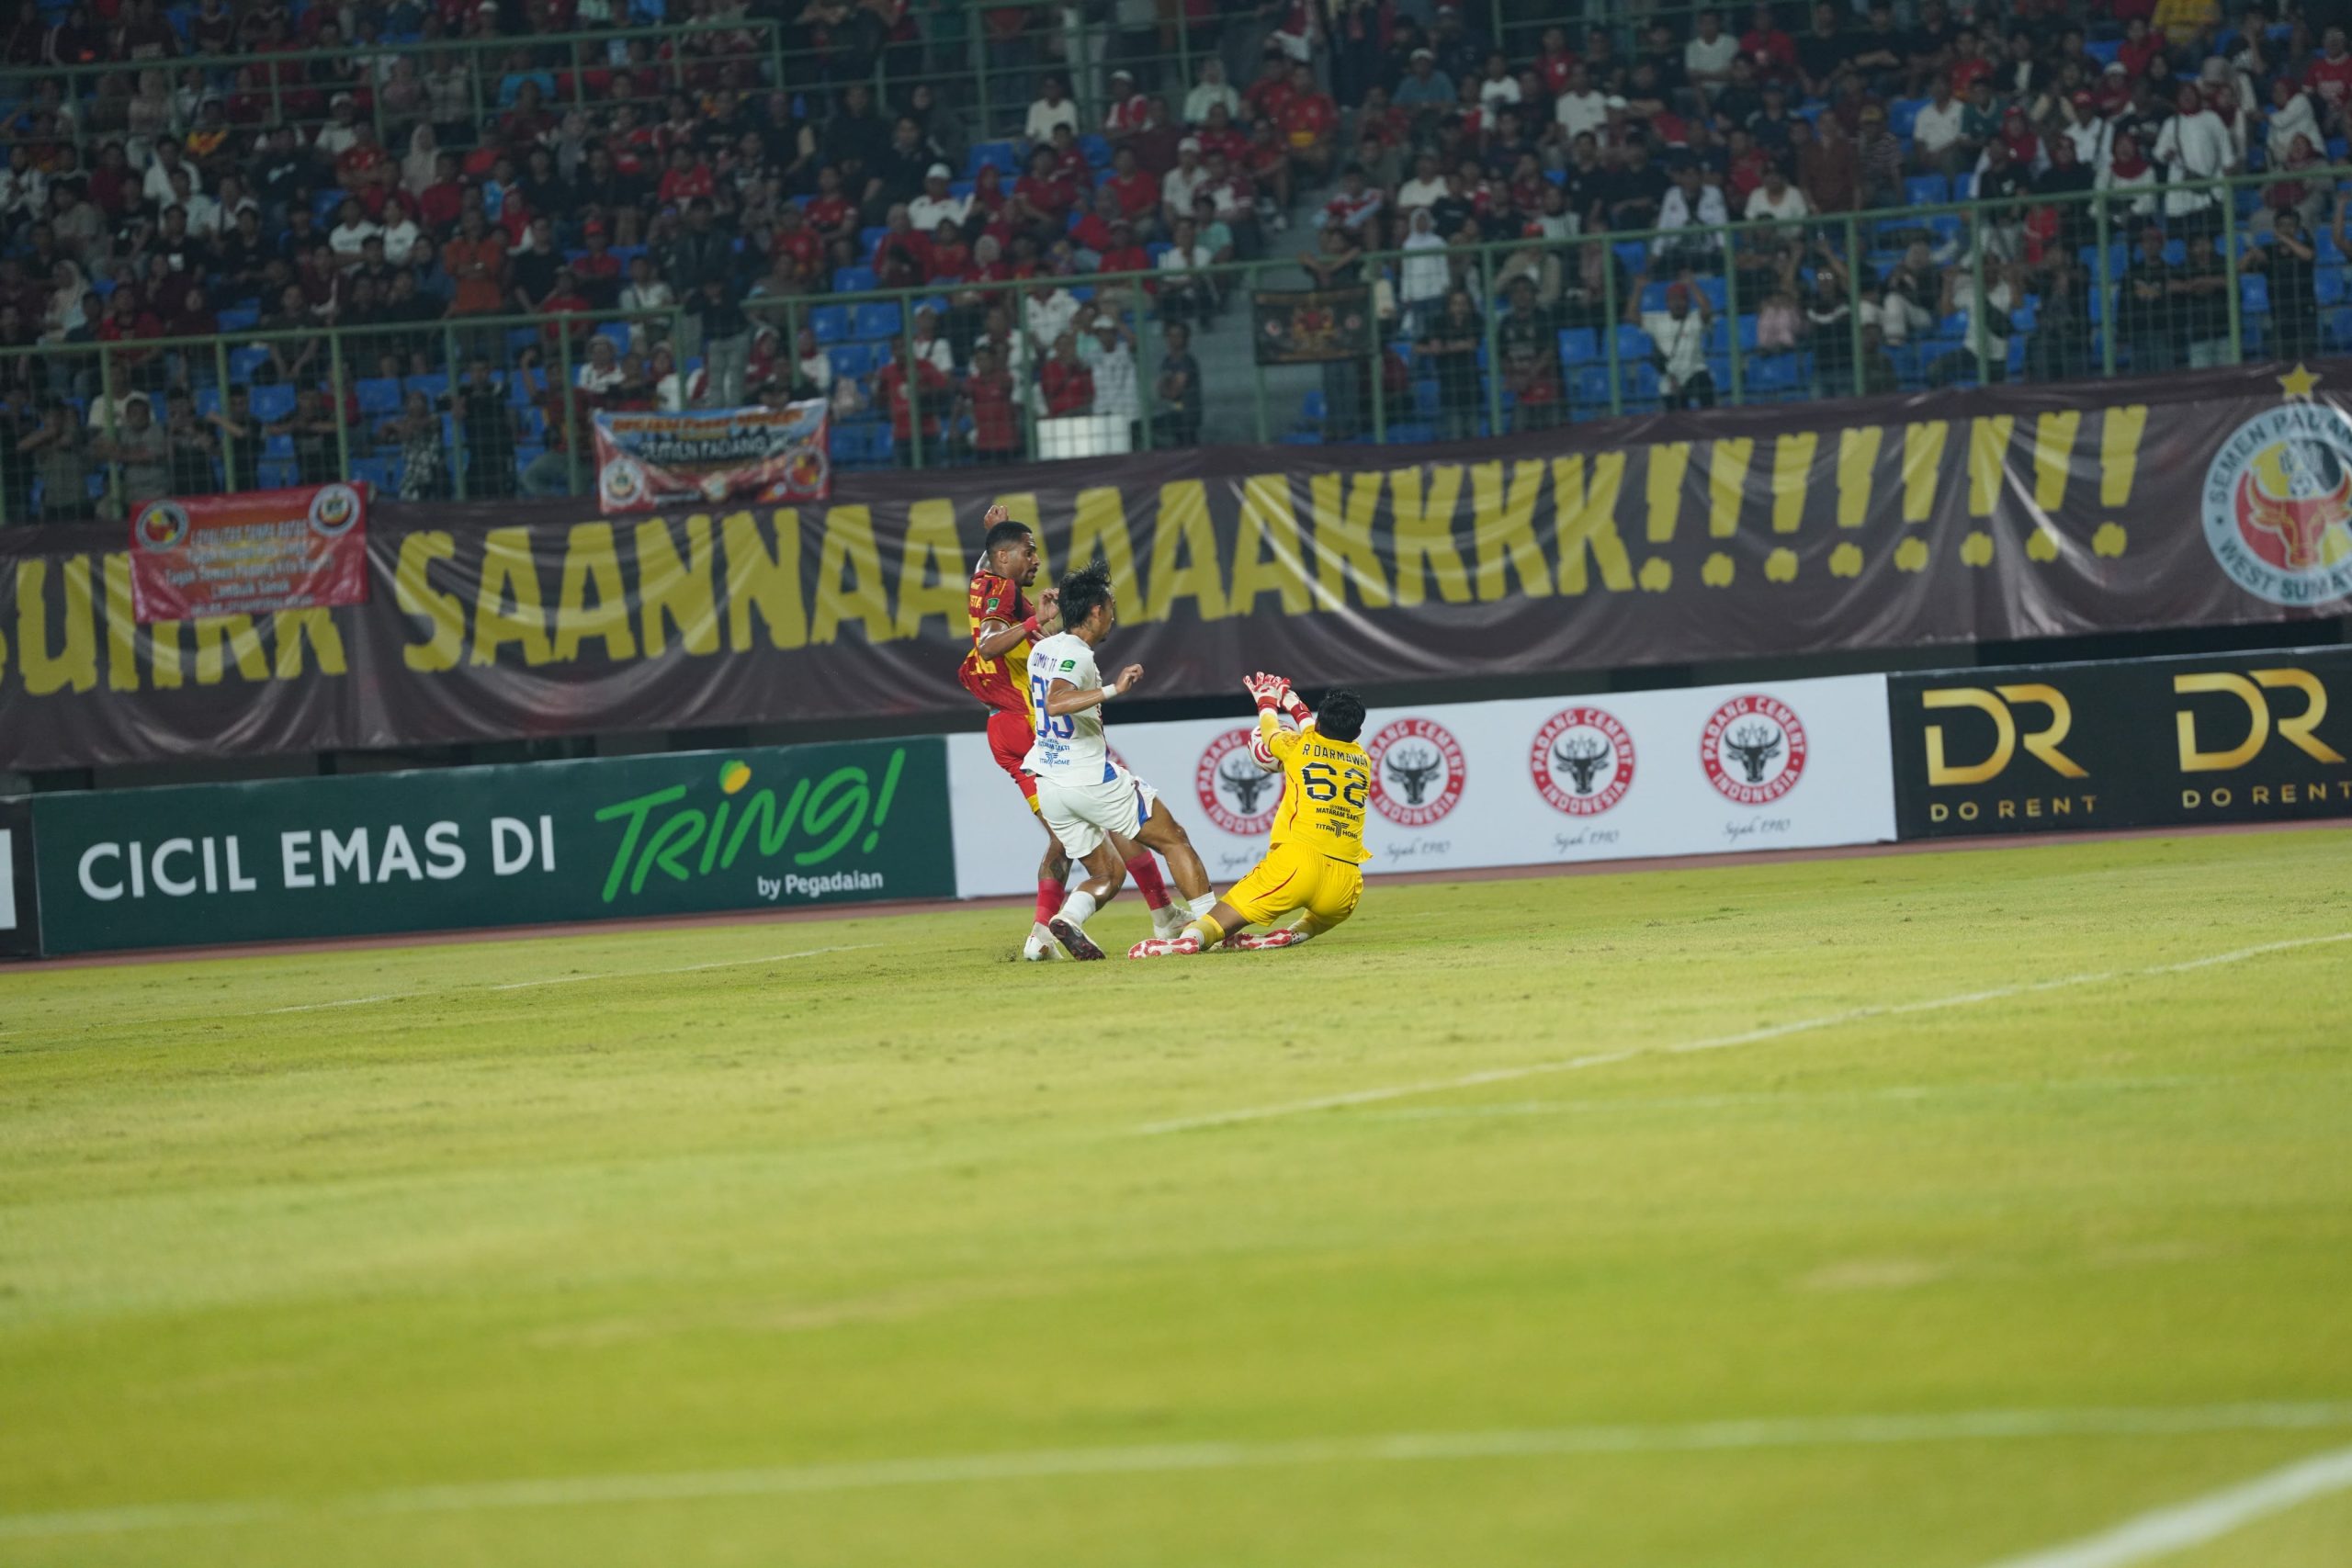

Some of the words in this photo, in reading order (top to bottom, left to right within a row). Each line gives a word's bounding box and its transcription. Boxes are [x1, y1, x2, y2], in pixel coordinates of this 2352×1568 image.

[2209, 423, 2267, 503] SEMEN
[2220, 538, 2279, 591] WEST
[1532, 709, 1577, 772] PADANG
[1584, 709, 1633, 765] CEMENT
[1702, 697, 1749, 761] PADANG
[1756, 696, 1804, 753] CEMENT
[1923, 683, 2090, 786] DR
[2174, 668, 2346, 773] DR
[1198, 731, 1243, 792] PADANG
[1302, 743, 1311, 756] R
[1416, 720, 1464, 775] CEMENT
[1543, 781, 1626, 813] INDONESIA
[1713, 769, 1799, 802] INDONESIA
[2182, 787, 2232, 808] DO
[2252, 781, 2352, 806] RENT
[1316, 807, 1345, 818] MATARAM
[1316, 823, 1336, 833] TITAN
[1374, 792, 1458, 824] INDONESIA
[1930, 801, 1979, 822] DO
[1998, 795, 2098, 819] RENT
[77, 835, 257, 901] CICIL
[281, 821, 467, 888] EMAS
[491, 815, 556, 876] DI
[757, 874, 781, 900] by
[786, 871, 884, 899] Pegadaian
